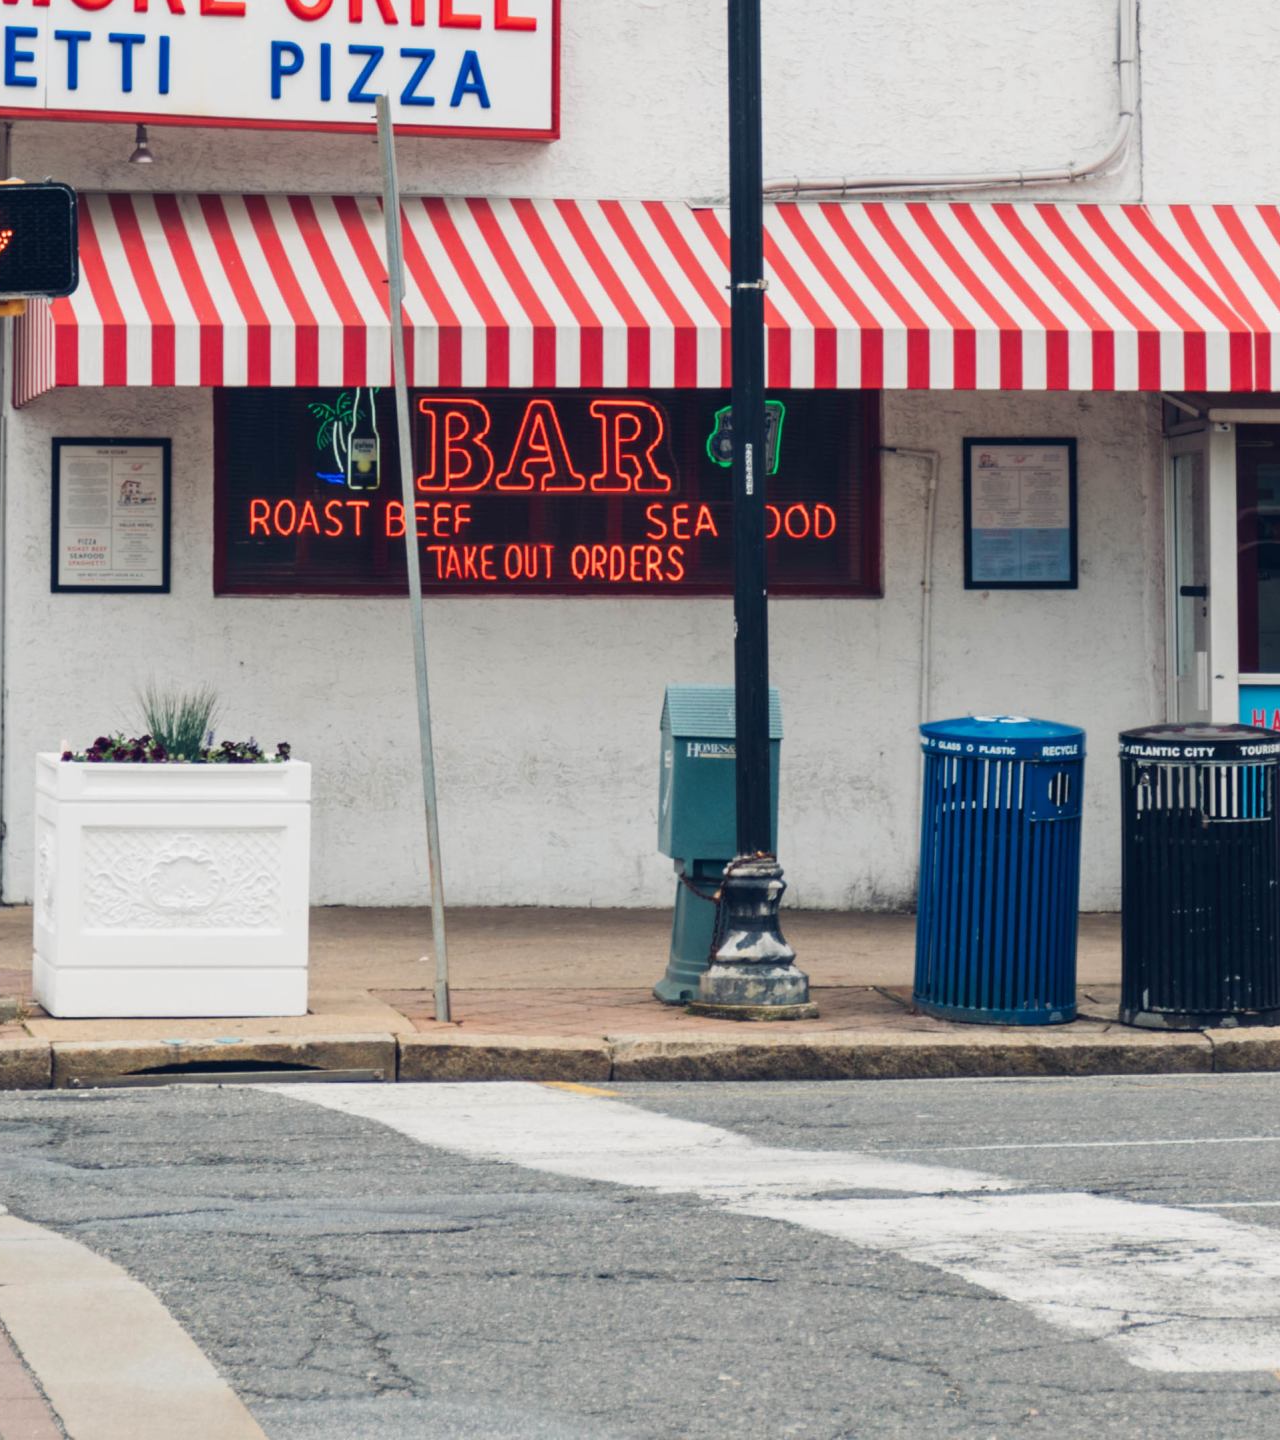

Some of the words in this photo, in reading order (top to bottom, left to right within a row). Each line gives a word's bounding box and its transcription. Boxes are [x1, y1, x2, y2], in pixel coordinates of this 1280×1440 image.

[270, 40, 490, 109] PIZZA
[417, 398, 672, 493] BAR
[250, 499, 370, 536] ROAST
[385, 502, 471, 538] BEEF
[646, 503, 718, 539] SEA
[765, 503, 837, 539] OOD
[428, 545, 497, 580] TAKE
[505, 545, 555, 580] OUT
[571, 545, 685, 581] ORDERS
[938, 742, 962, 751] GLASS
[979, 746, 1016, 755] PLASTIC
[1042, 744, 1078, 756] RECYCLE
[1130, 745, 1180, 757] ATLANTIC
[1184, 747, 1216, 758] CITY
